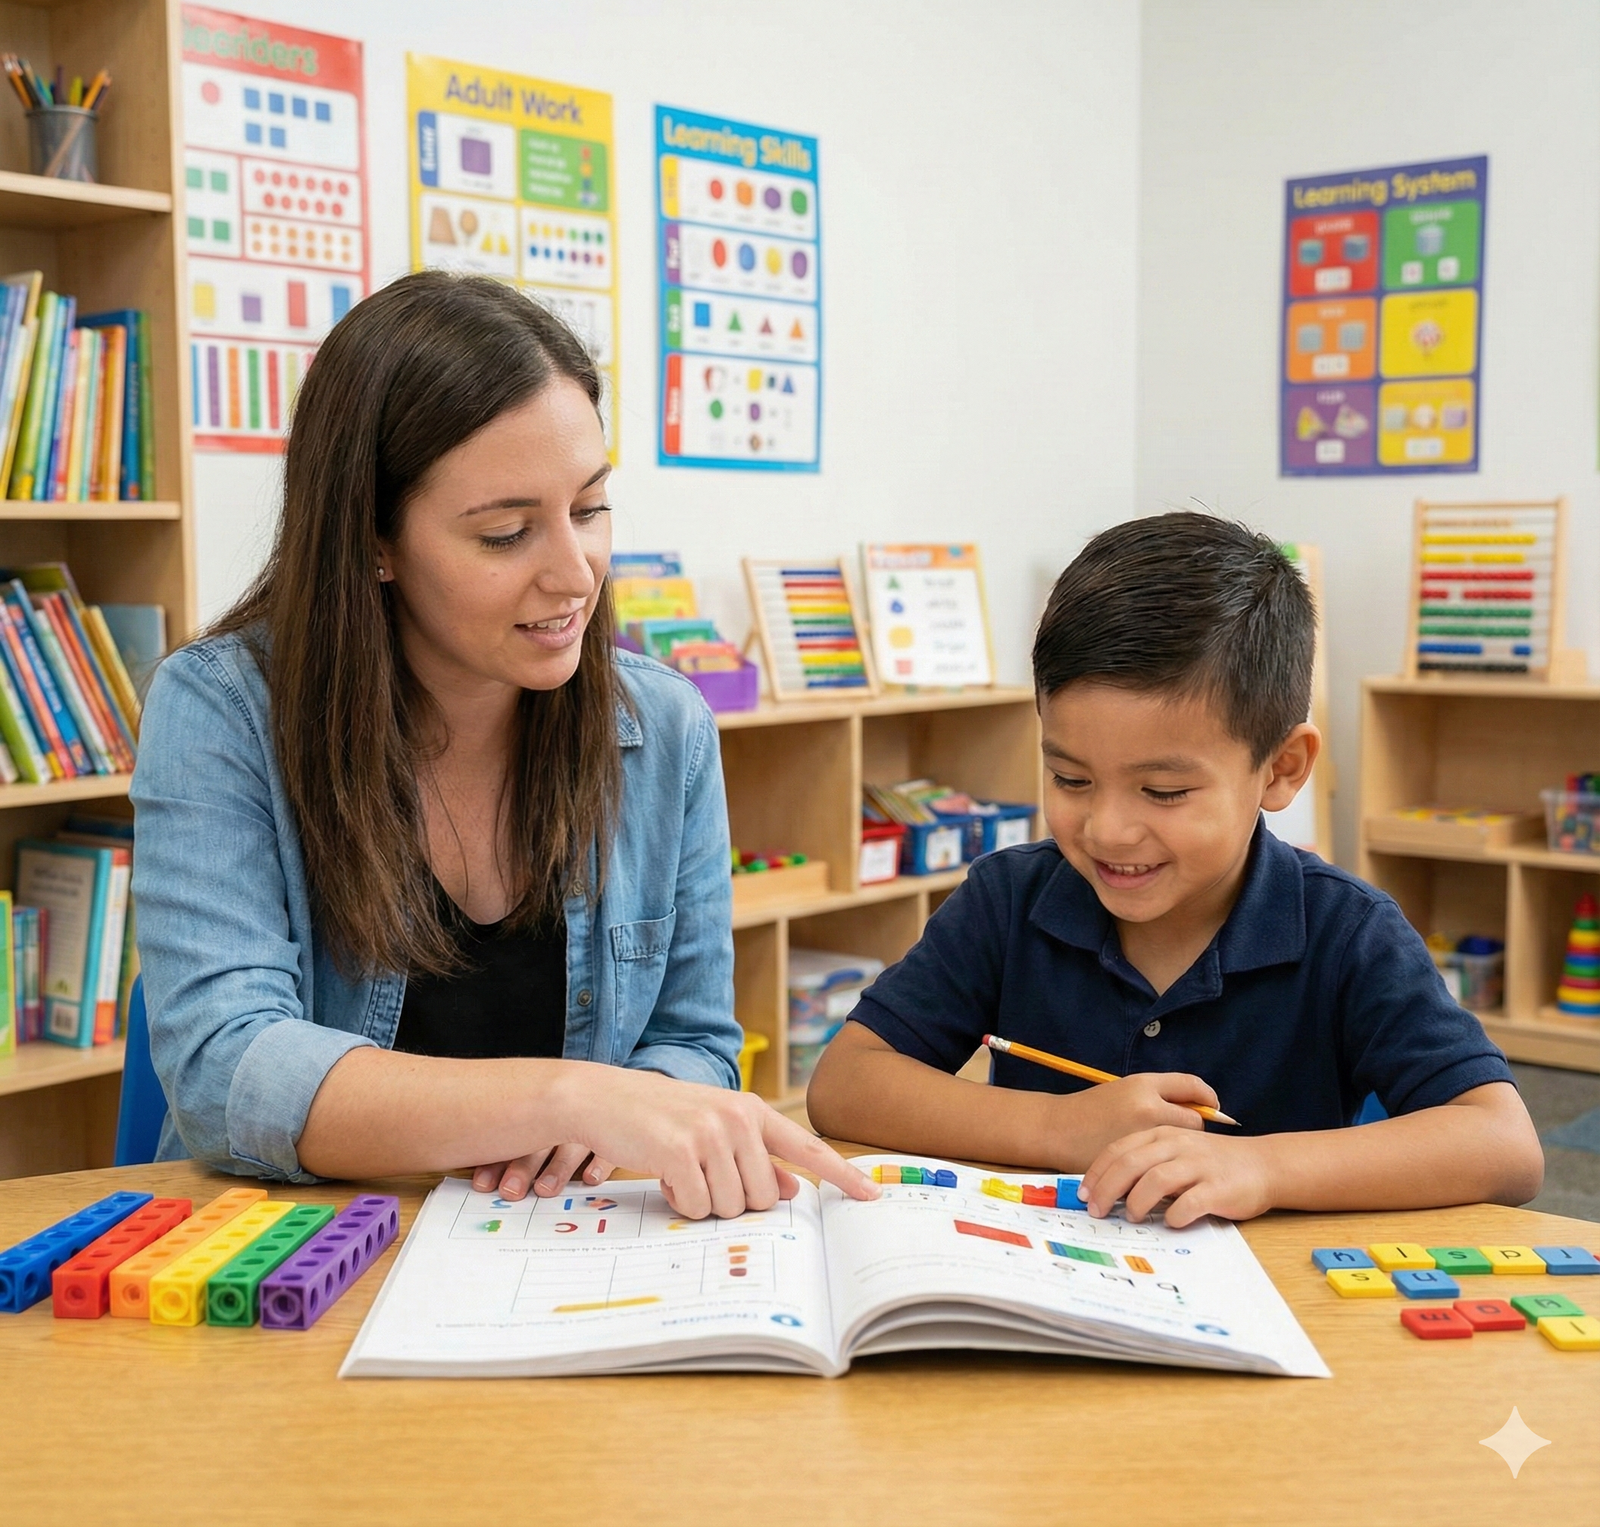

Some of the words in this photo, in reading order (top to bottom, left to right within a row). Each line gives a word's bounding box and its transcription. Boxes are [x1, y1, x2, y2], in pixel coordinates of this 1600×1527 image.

[445, 74, 513, 111] Adult
[519, 87, 583, 125] Work
[662, 114, 758, 168] Learning
[760, 135, 812, 172] Skills
[1293, 179, 1388, 209] Learning
[1392, 170, 1477, 202] System
